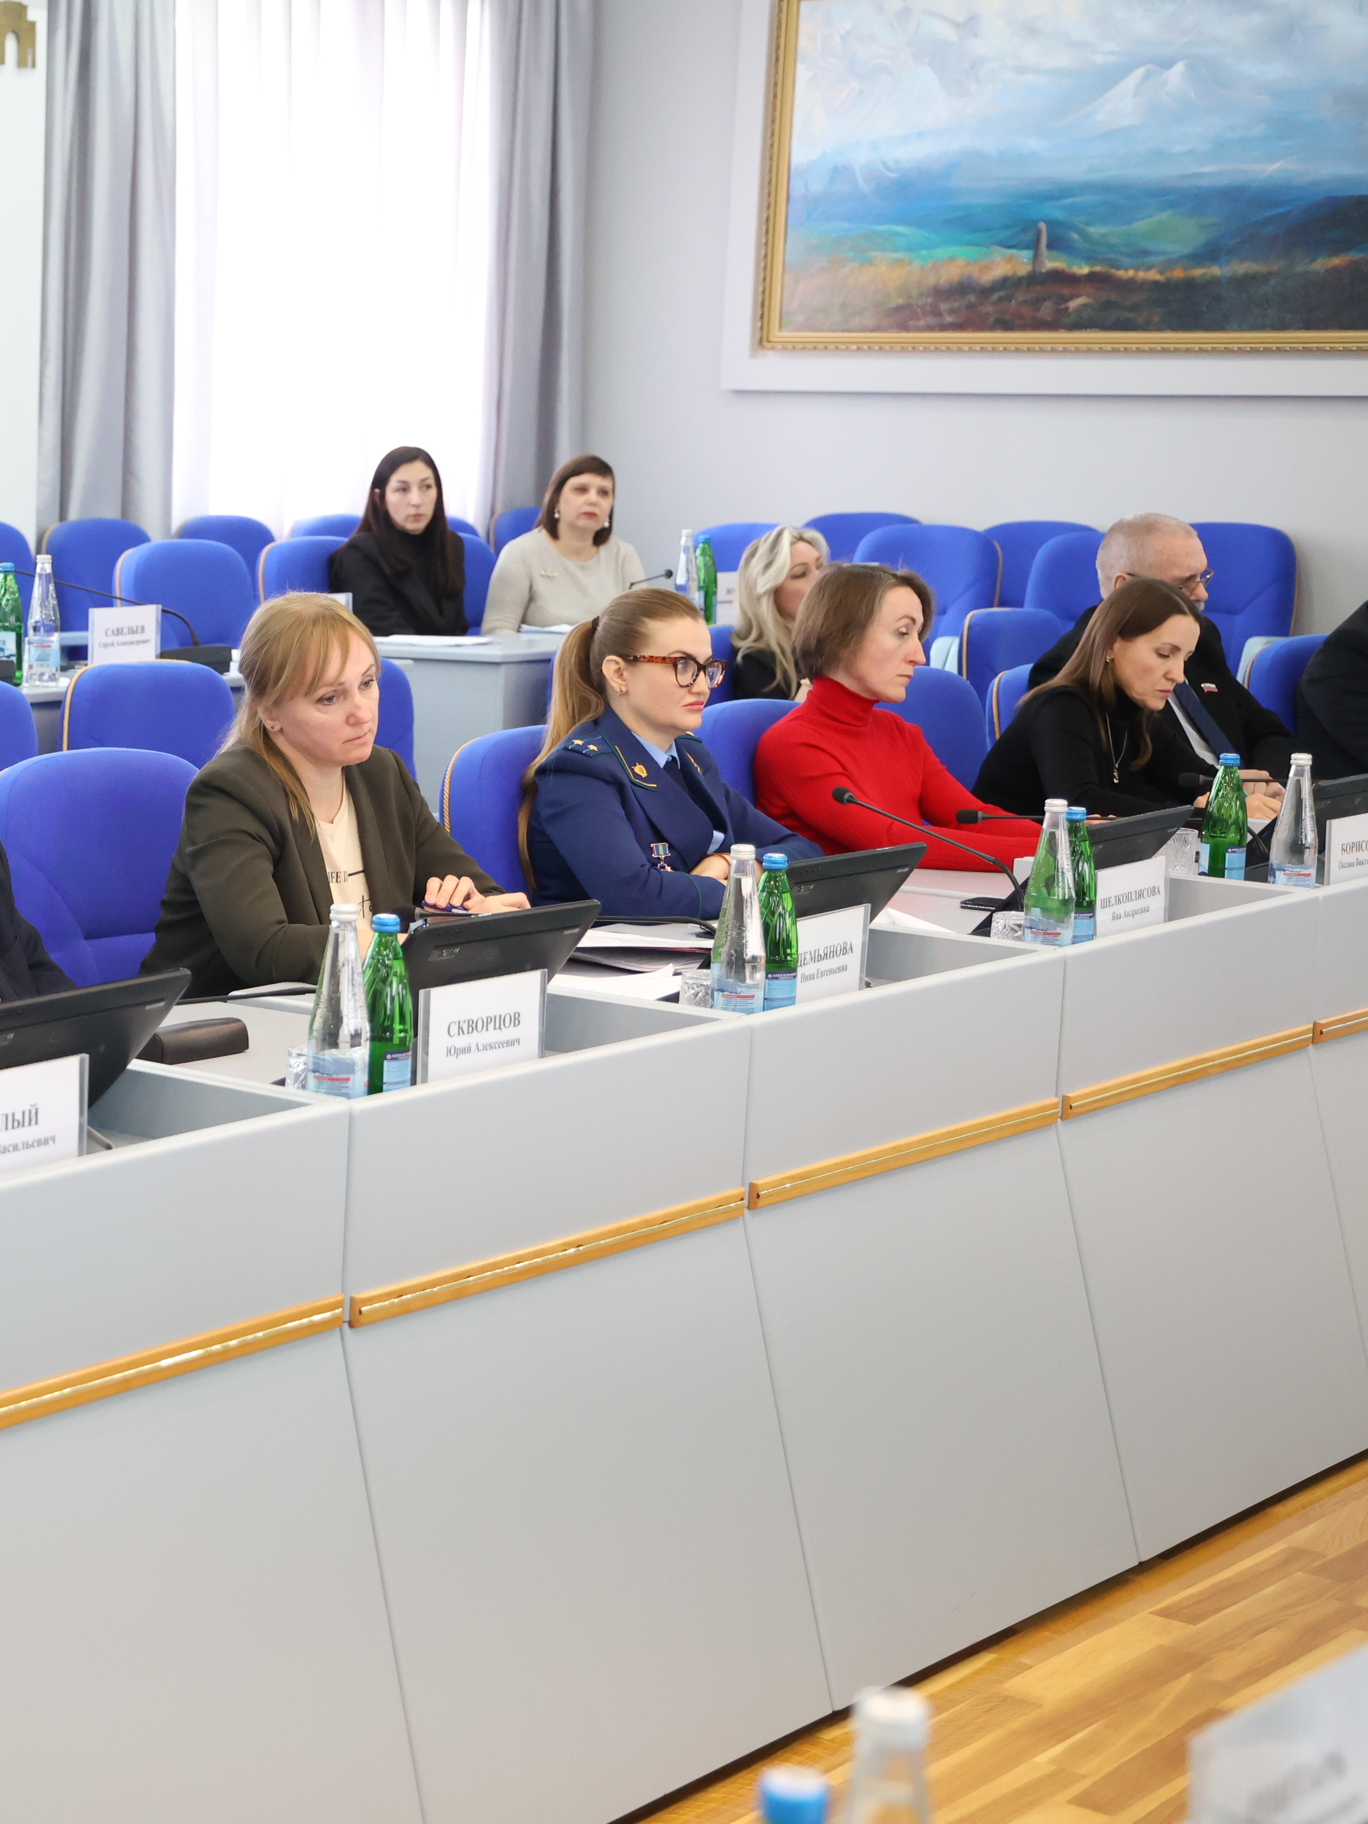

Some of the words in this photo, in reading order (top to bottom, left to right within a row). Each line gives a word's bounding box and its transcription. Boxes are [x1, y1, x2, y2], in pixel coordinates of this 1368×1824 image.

[800, 972, 815, 983] Нина
[816, 964, 848, 979] Евгеньевна
[447, 1011, 521, 1038] СКВОРЦОВ
[446, 1043, 472, 1059] Юрий
[473, 1038, 521, 1053] Алексеевич
